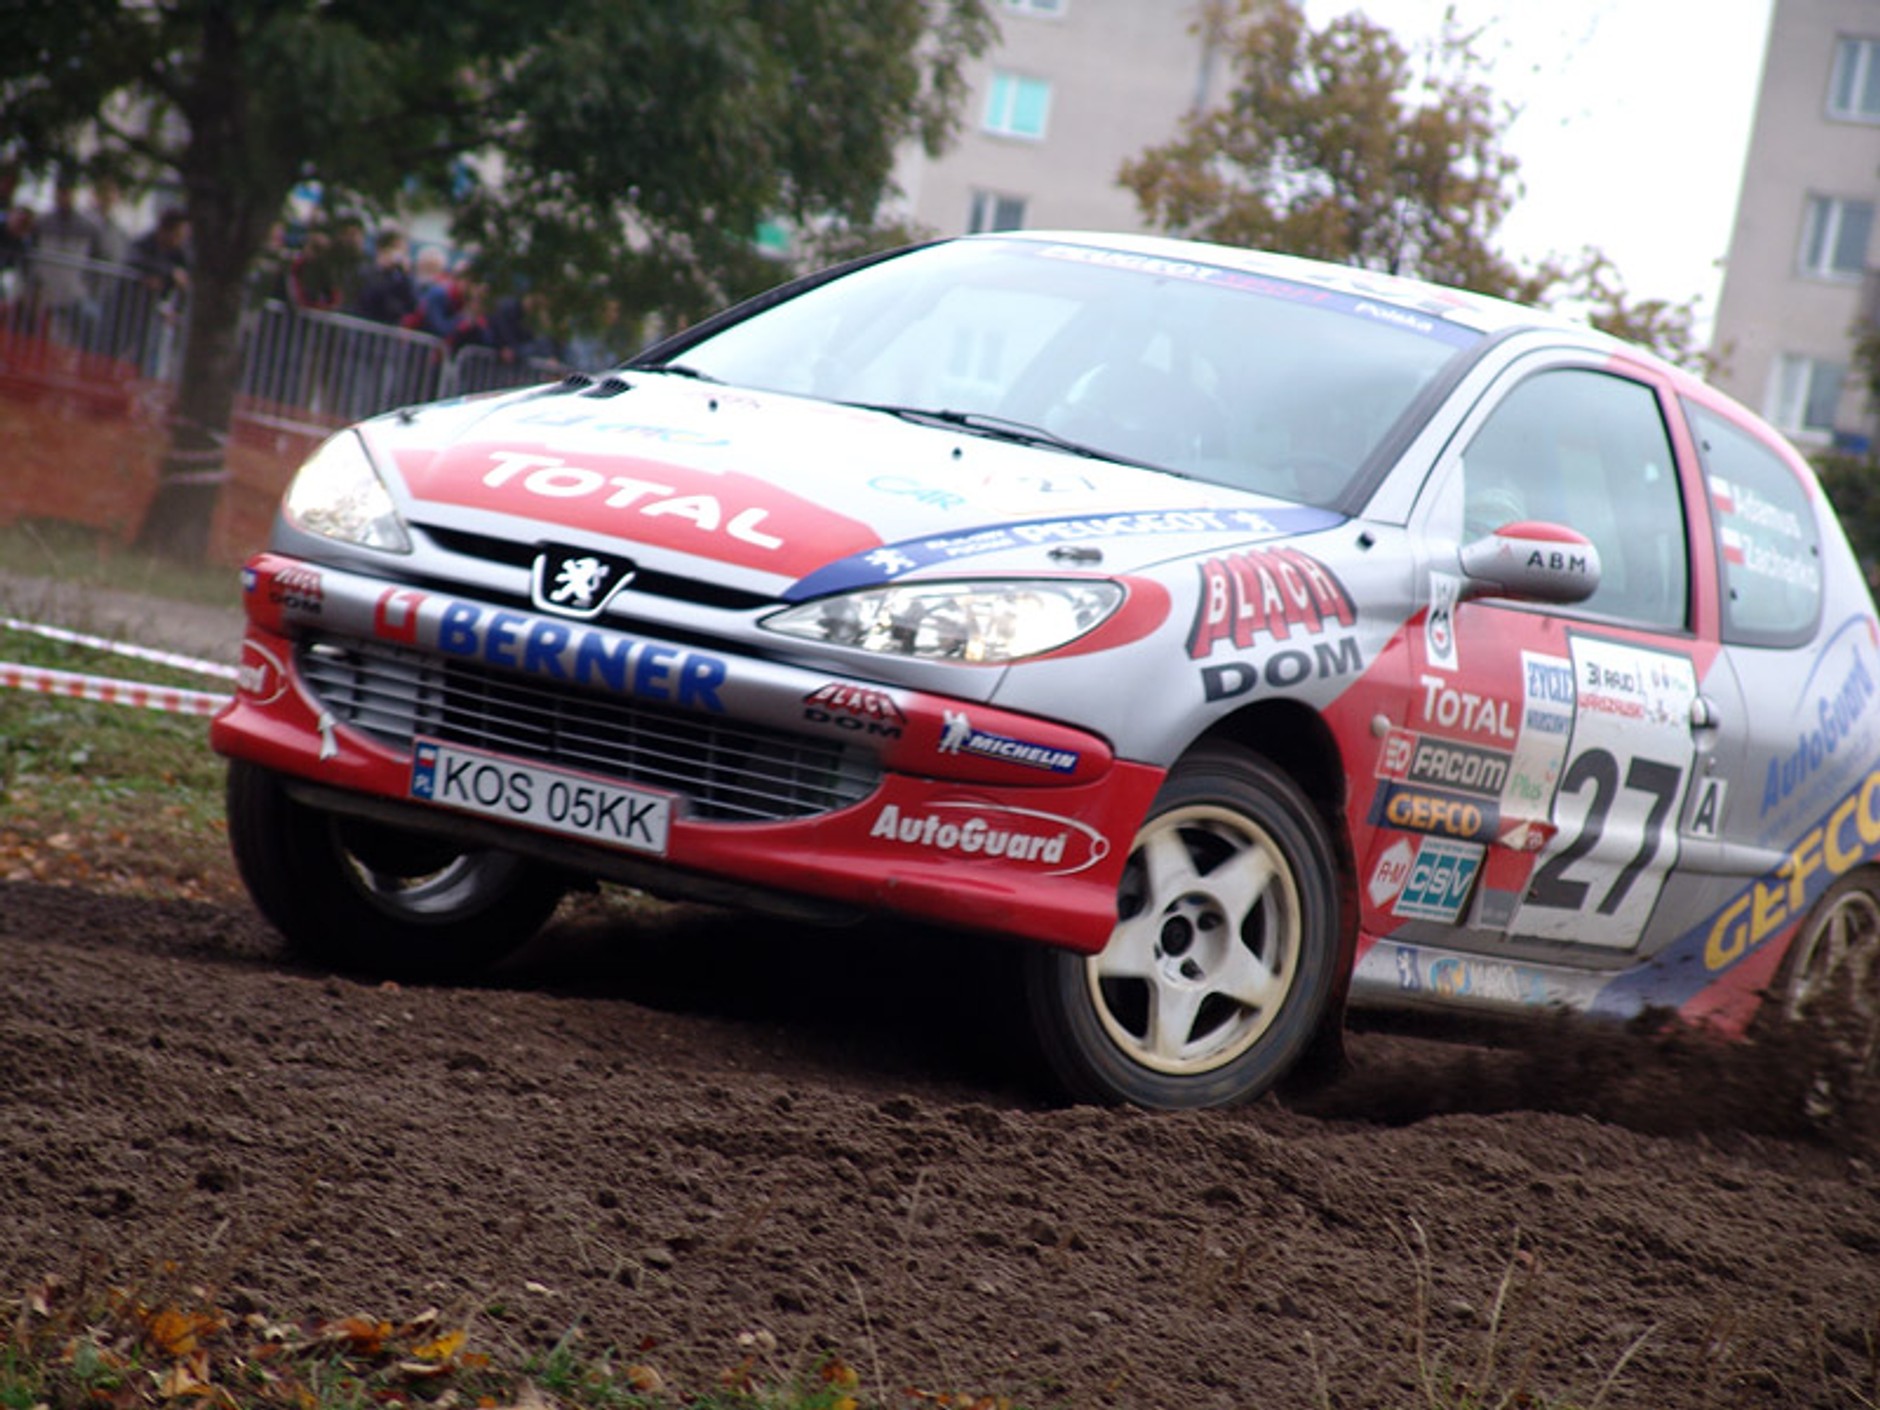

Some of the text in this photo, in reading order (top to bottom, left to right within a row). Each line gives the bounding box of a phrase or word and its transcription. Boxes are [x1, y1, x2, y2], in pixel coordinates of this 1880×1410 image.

[482, 451, 785, 550] TOTAL
[1013, 509, 1227, 544] PEUGEOT
[1526, 550, 1587, 573] ABM
[438, 601, 728, 714] BERNER
[1200, 636, 1364, 703] DOM
[804, 708, 902, 739] DOM
[1420, 674, 1516, 738] TOTAL
[968, 735, 1076, 767] MICHELIN
[1412, 745, 1507, 790] FACOM
[443, 757, 657, 843] KOS 05KK
[1386, 792, 1482, 837] GEFCO
[1692, 781, 1718, 835] A
[869, 803, 1068, 864] AutoGuard
[1522, 747, 1682, 916] 27
[1408, 864, 1473, 897] CSV
